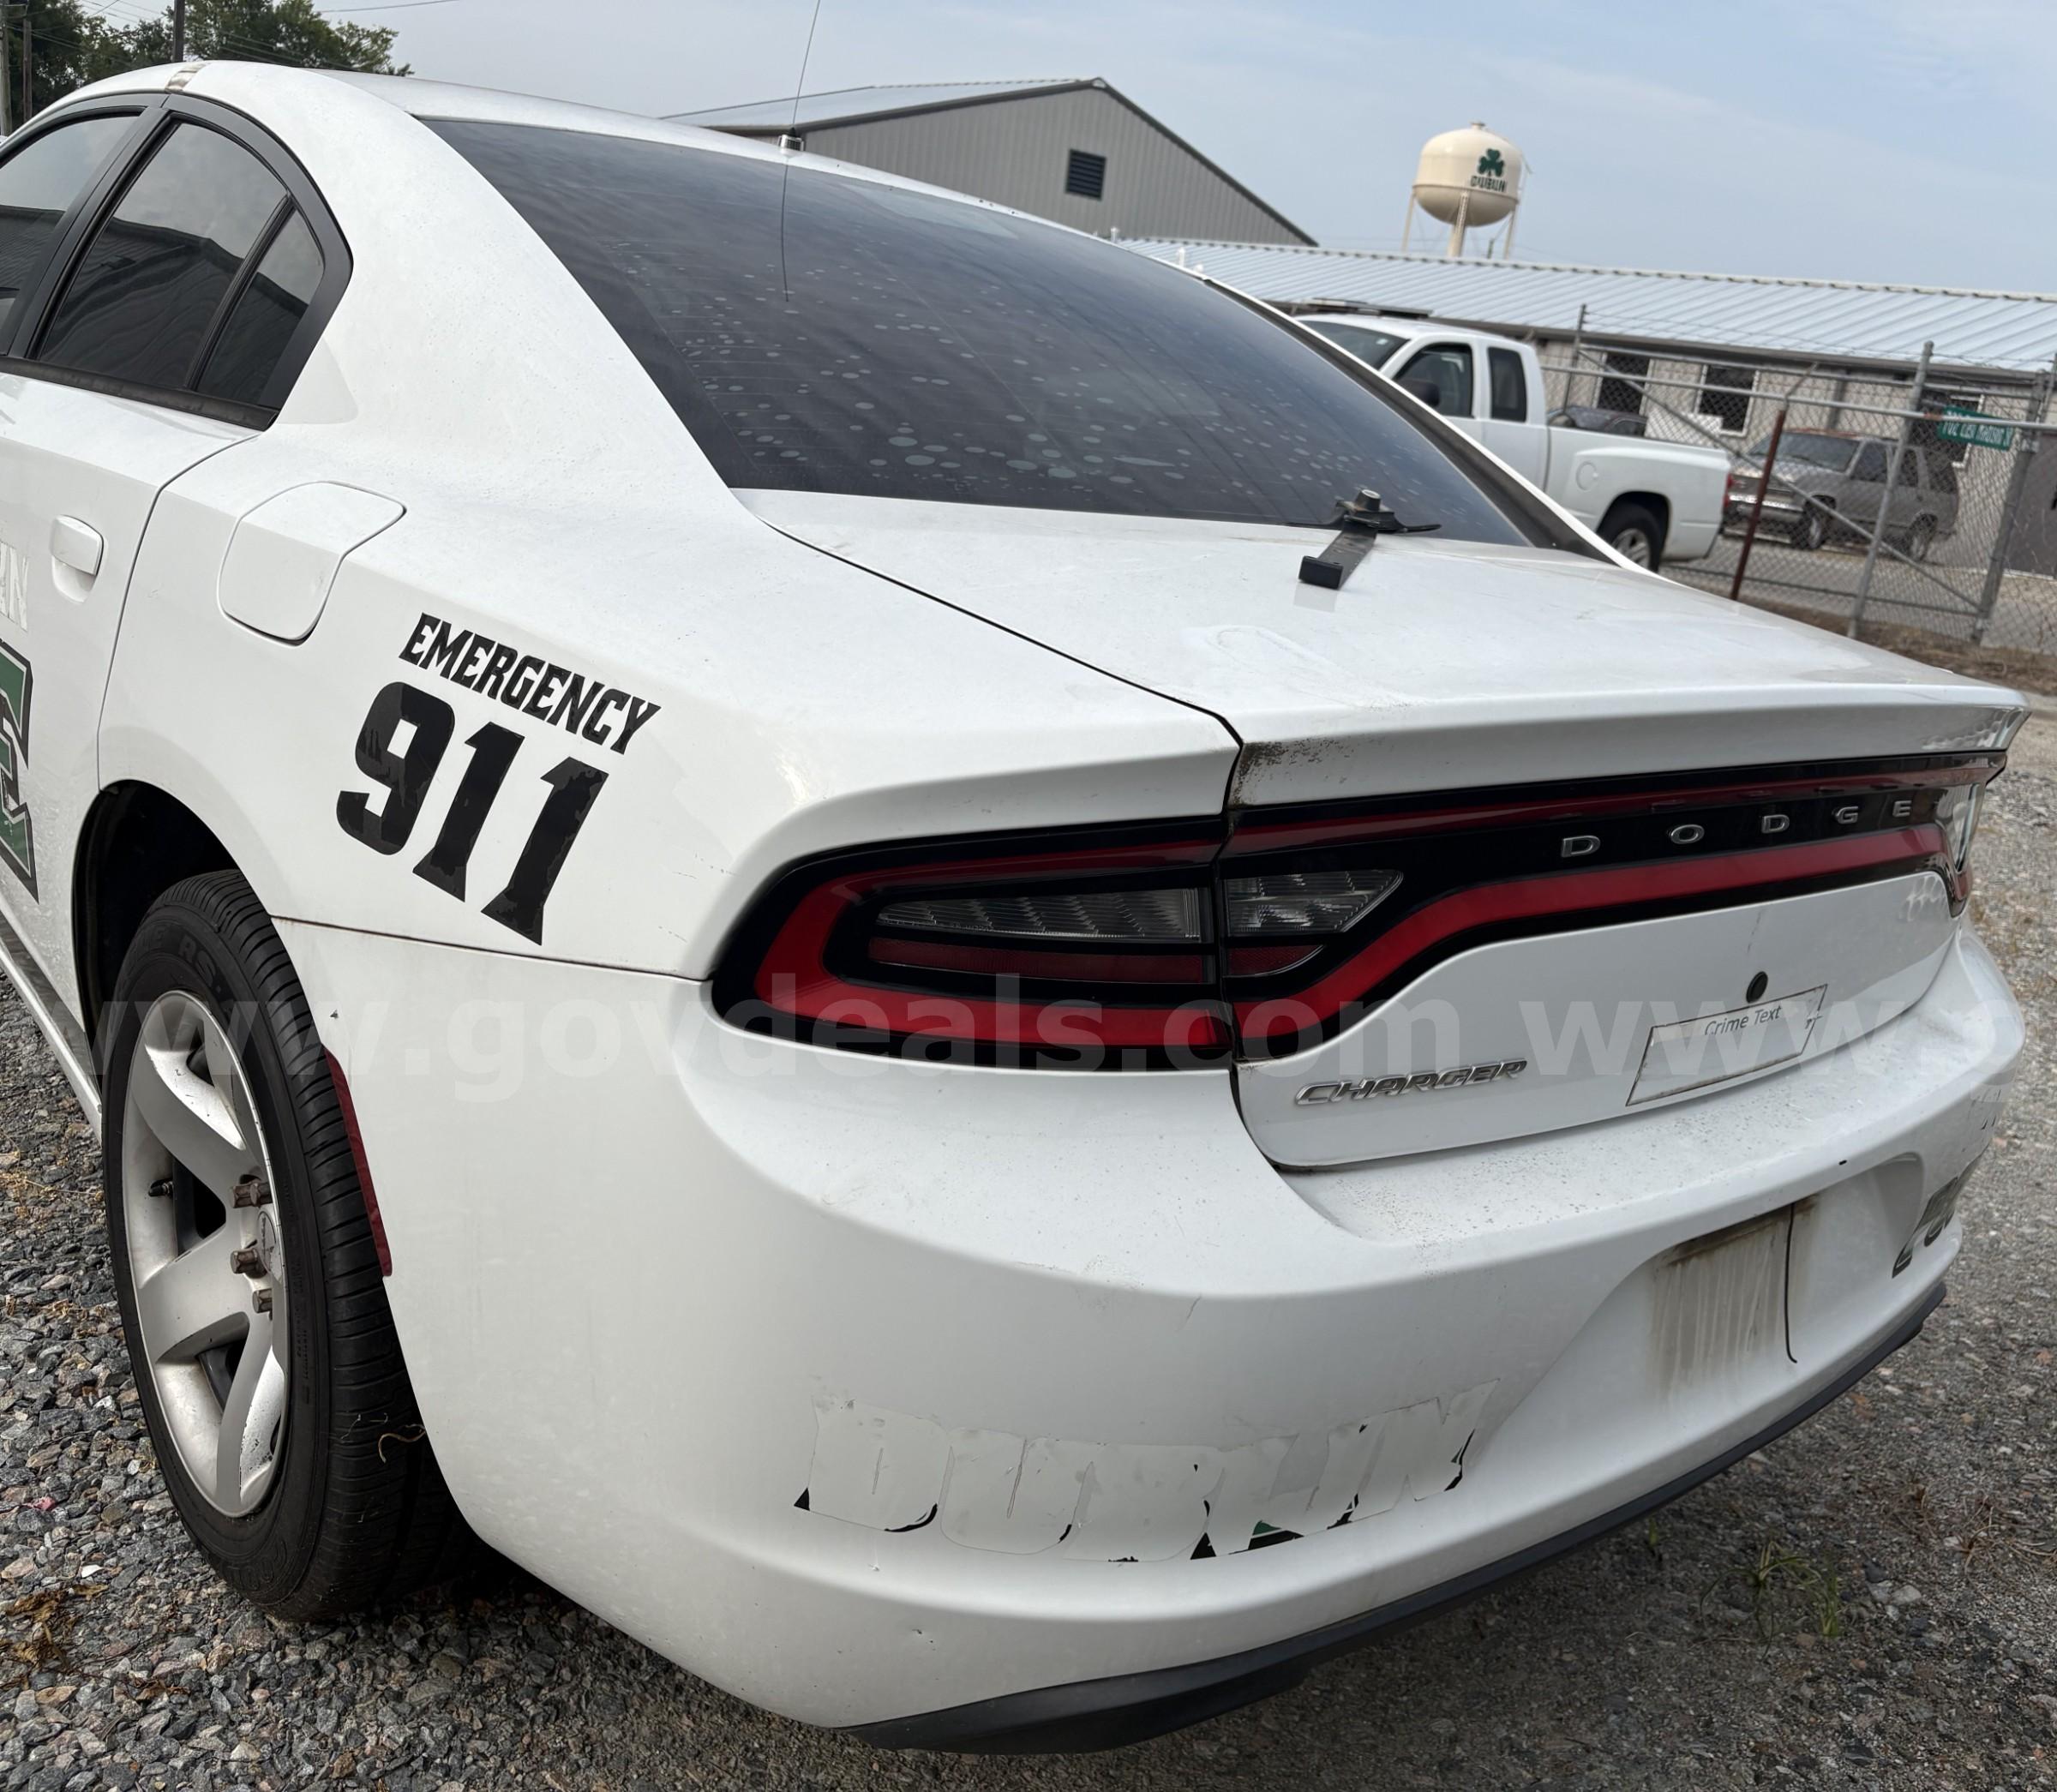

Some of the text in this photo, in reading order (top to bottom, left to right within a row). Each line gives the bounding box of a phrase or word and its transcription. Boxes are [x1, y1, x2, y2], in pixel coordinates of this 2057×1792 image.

[1471, 175, 1506, 193] DUBLIN
[399, 612, 662, 755] EMERGENCY
[336, 681, 609, 946] 911
[1560, 799, 1913, 858] DODGE
[1704, 1004, 1783, 1036] Crime Text
[1295, 1058, 1528, 1107] CHARGER
